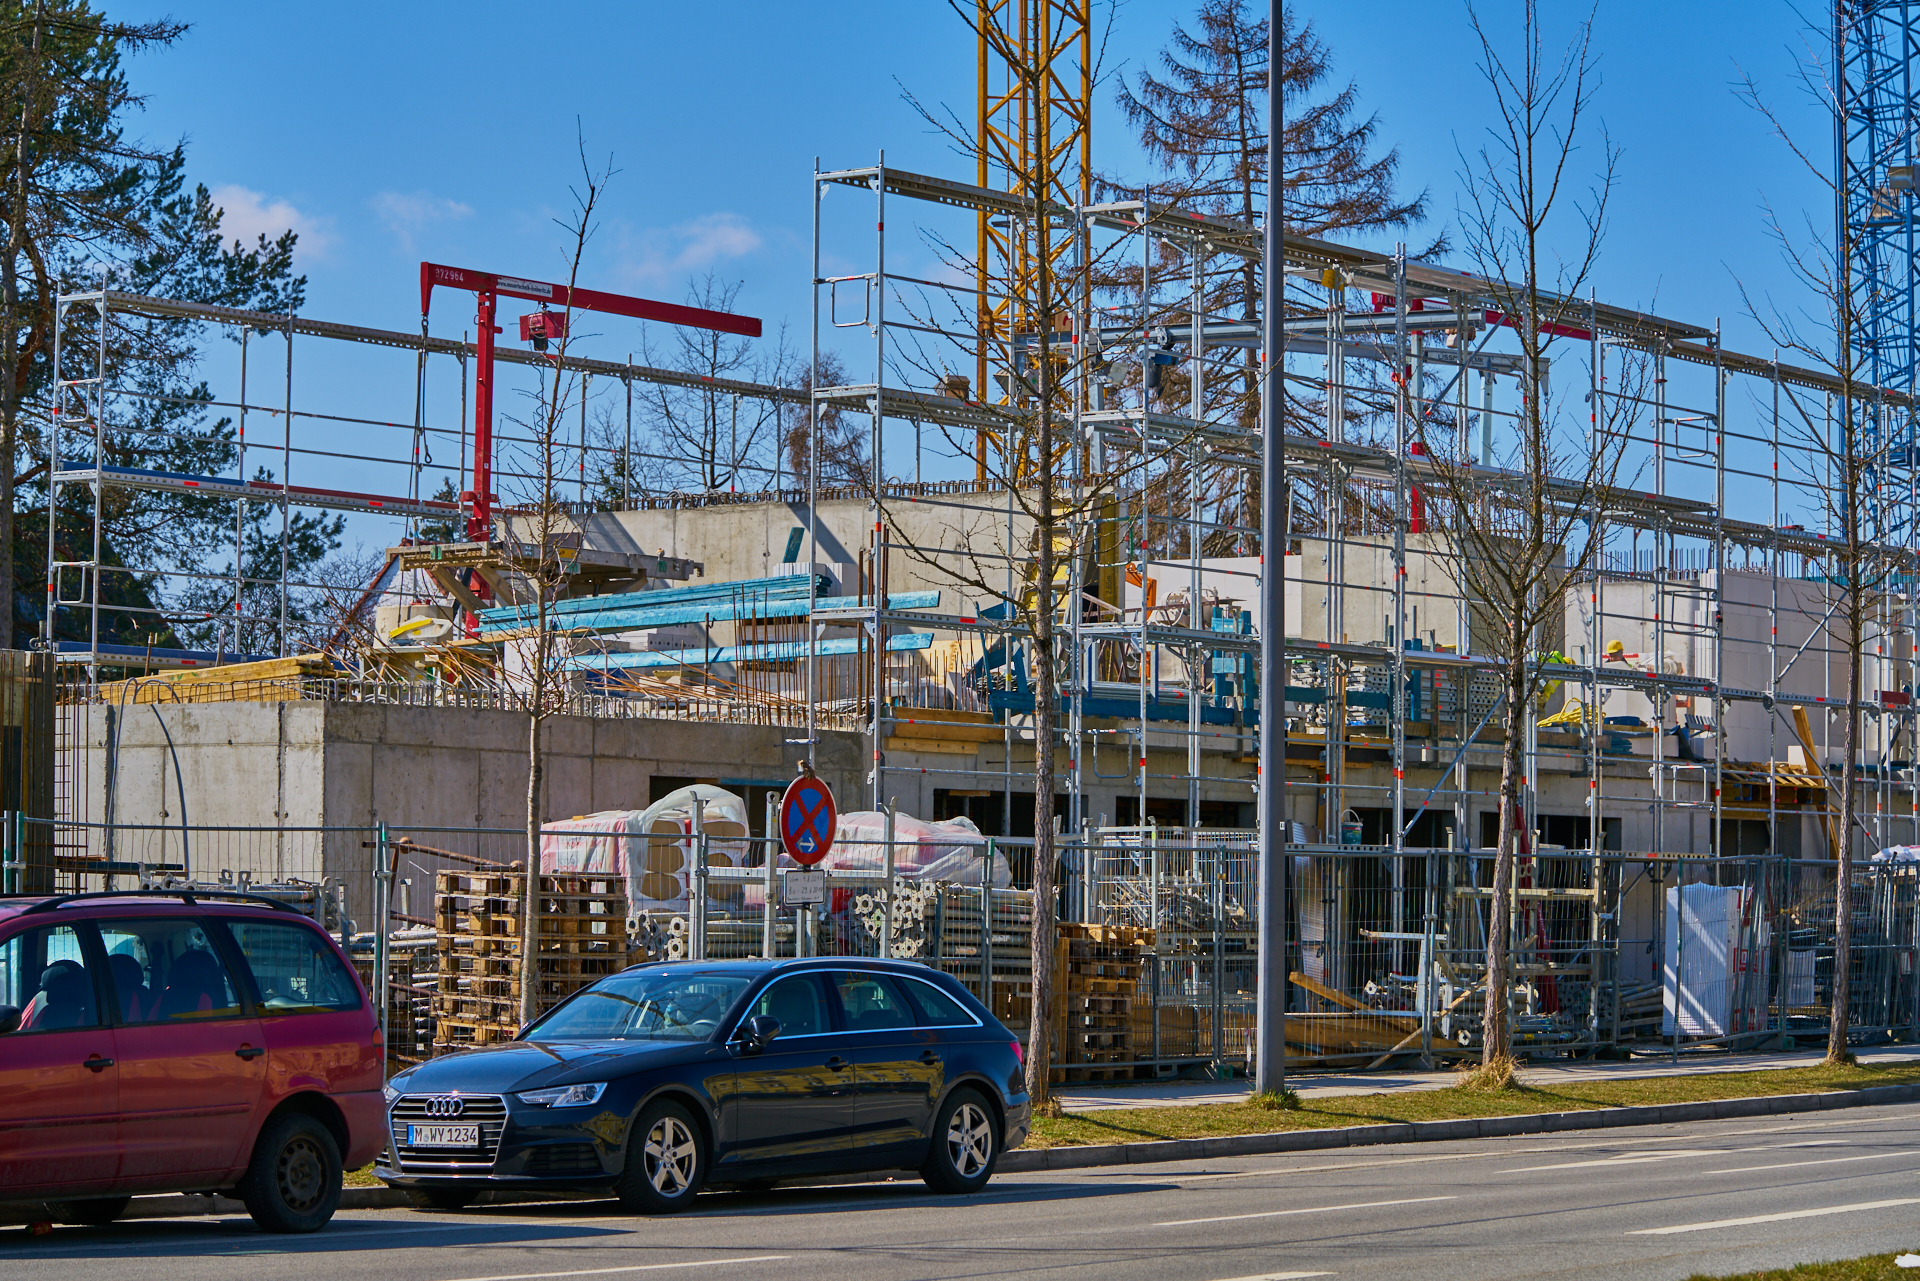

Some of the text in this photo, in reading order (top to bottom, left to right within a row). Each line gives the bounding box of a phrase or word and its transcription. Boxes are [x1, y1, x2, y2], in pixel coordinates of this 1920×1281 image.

[415, 1127, 477, 1143] M WY 1234
